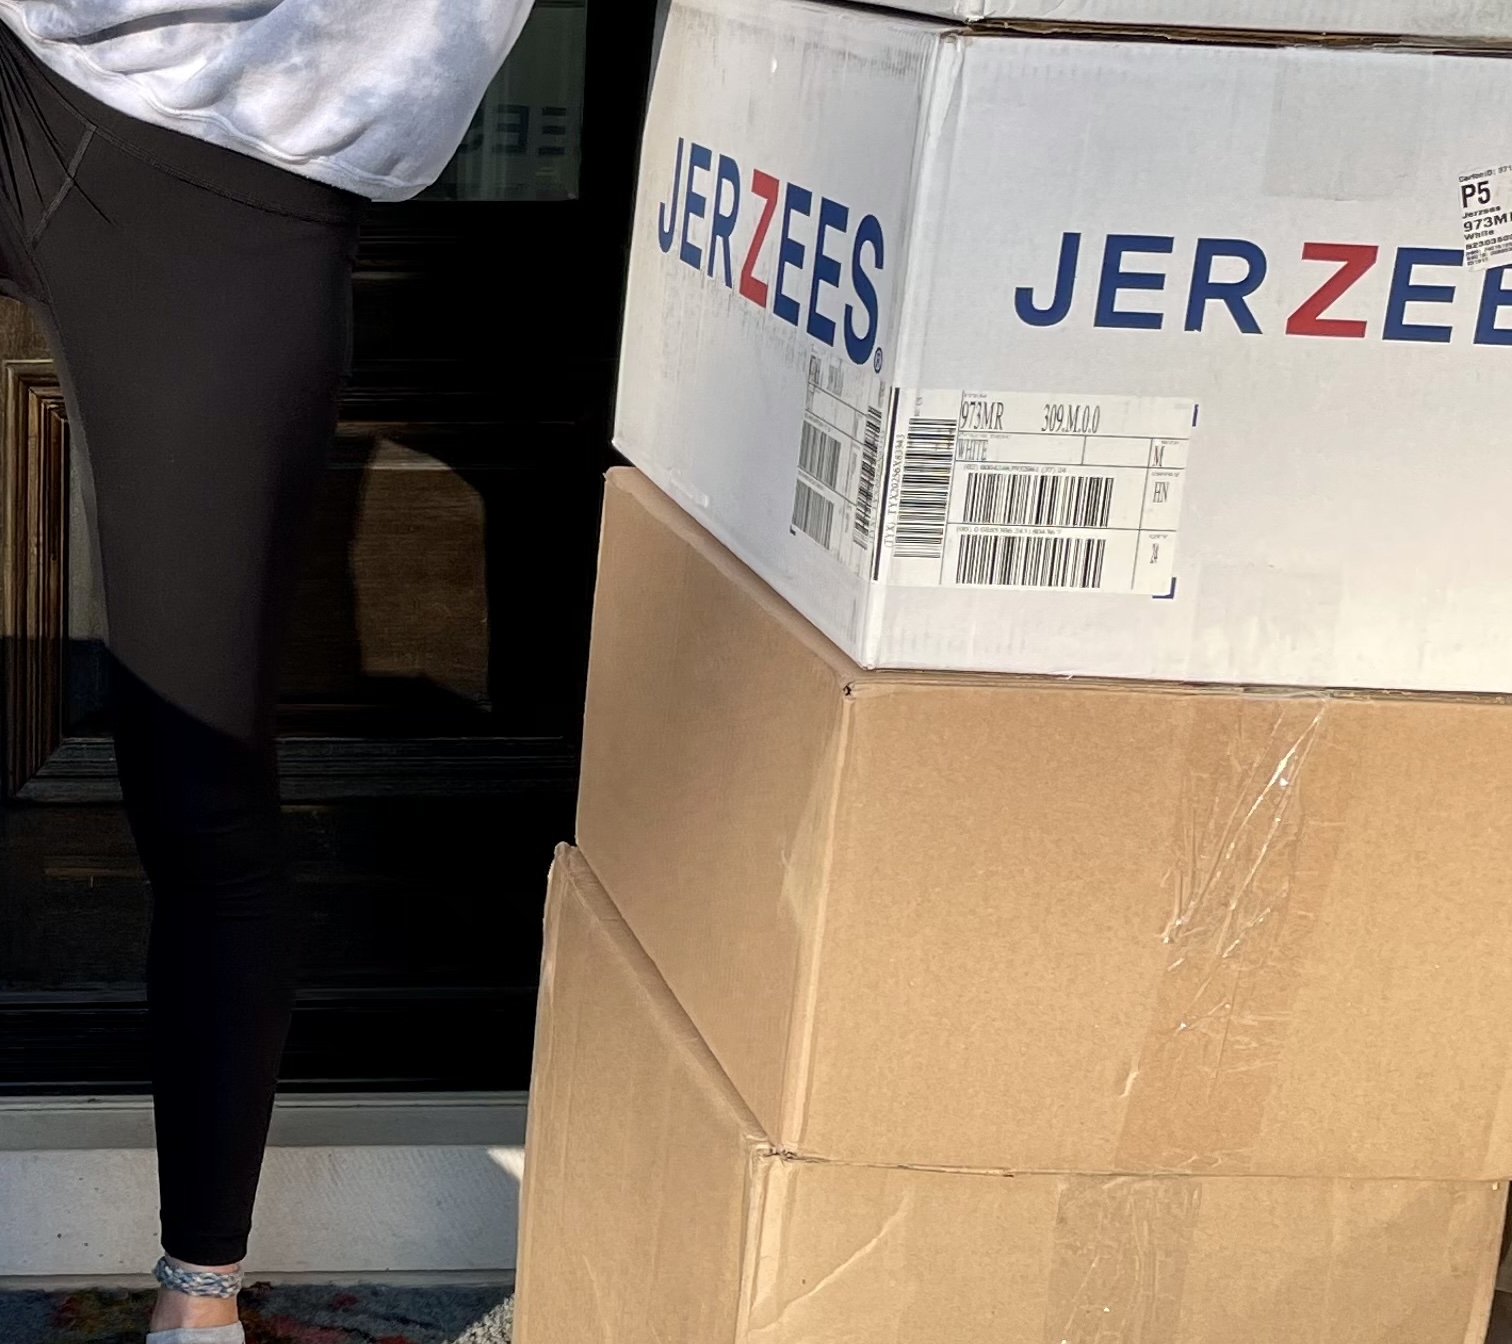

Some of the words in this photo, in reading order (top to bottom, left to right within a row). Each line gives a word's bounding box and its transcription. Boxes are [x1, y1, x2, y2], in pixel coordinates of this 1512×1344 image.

[1461, 180, 1491, 208] P5
[658, 137, 884, 365] JERZEES
[960, 401, 1004, 430] 973MR
[1041, 404, 1100, 434] 309.M.0.0
[957, 438, 988, 461] WHITE
